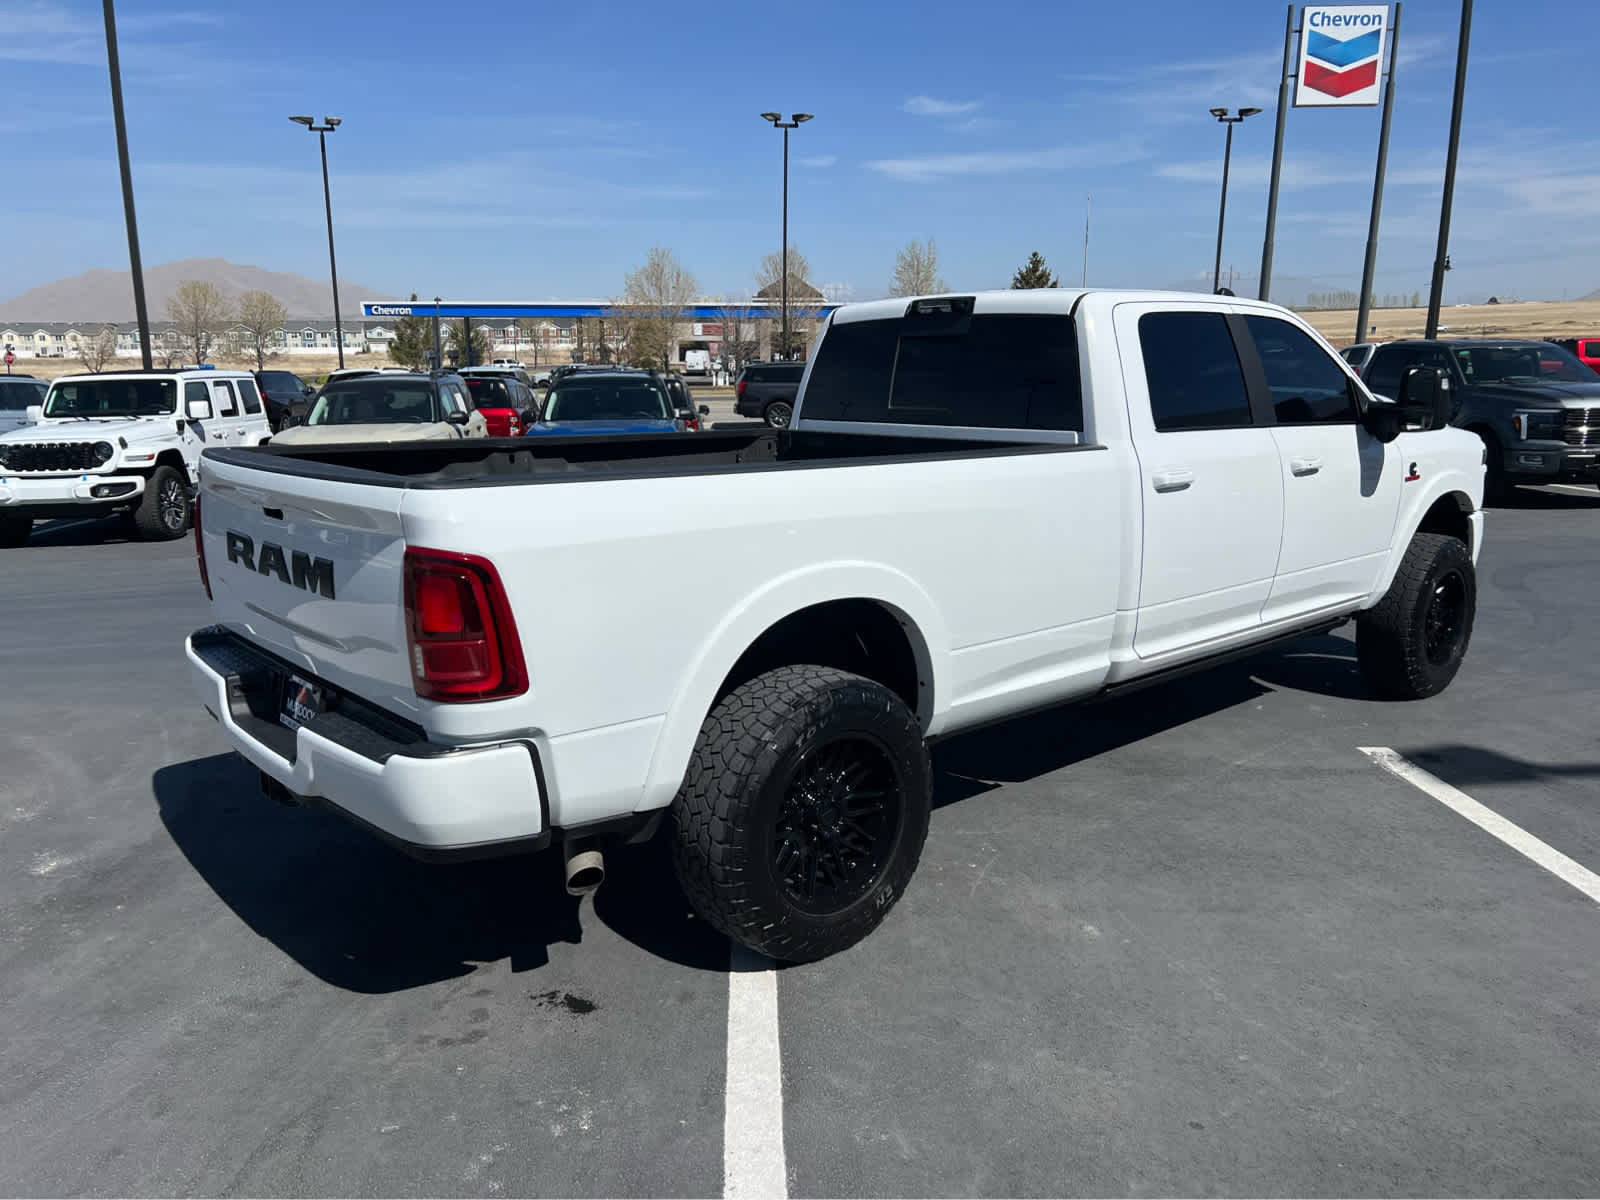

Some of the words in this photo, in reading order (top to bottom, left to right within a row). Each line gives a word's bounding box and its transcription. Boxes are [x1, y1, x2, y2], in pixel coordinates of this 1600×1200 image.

[1309, 11, 1382, 27] Chevron
[371, 305, 412, 315] Chevron
[226, 528, 335, 600] RAM
